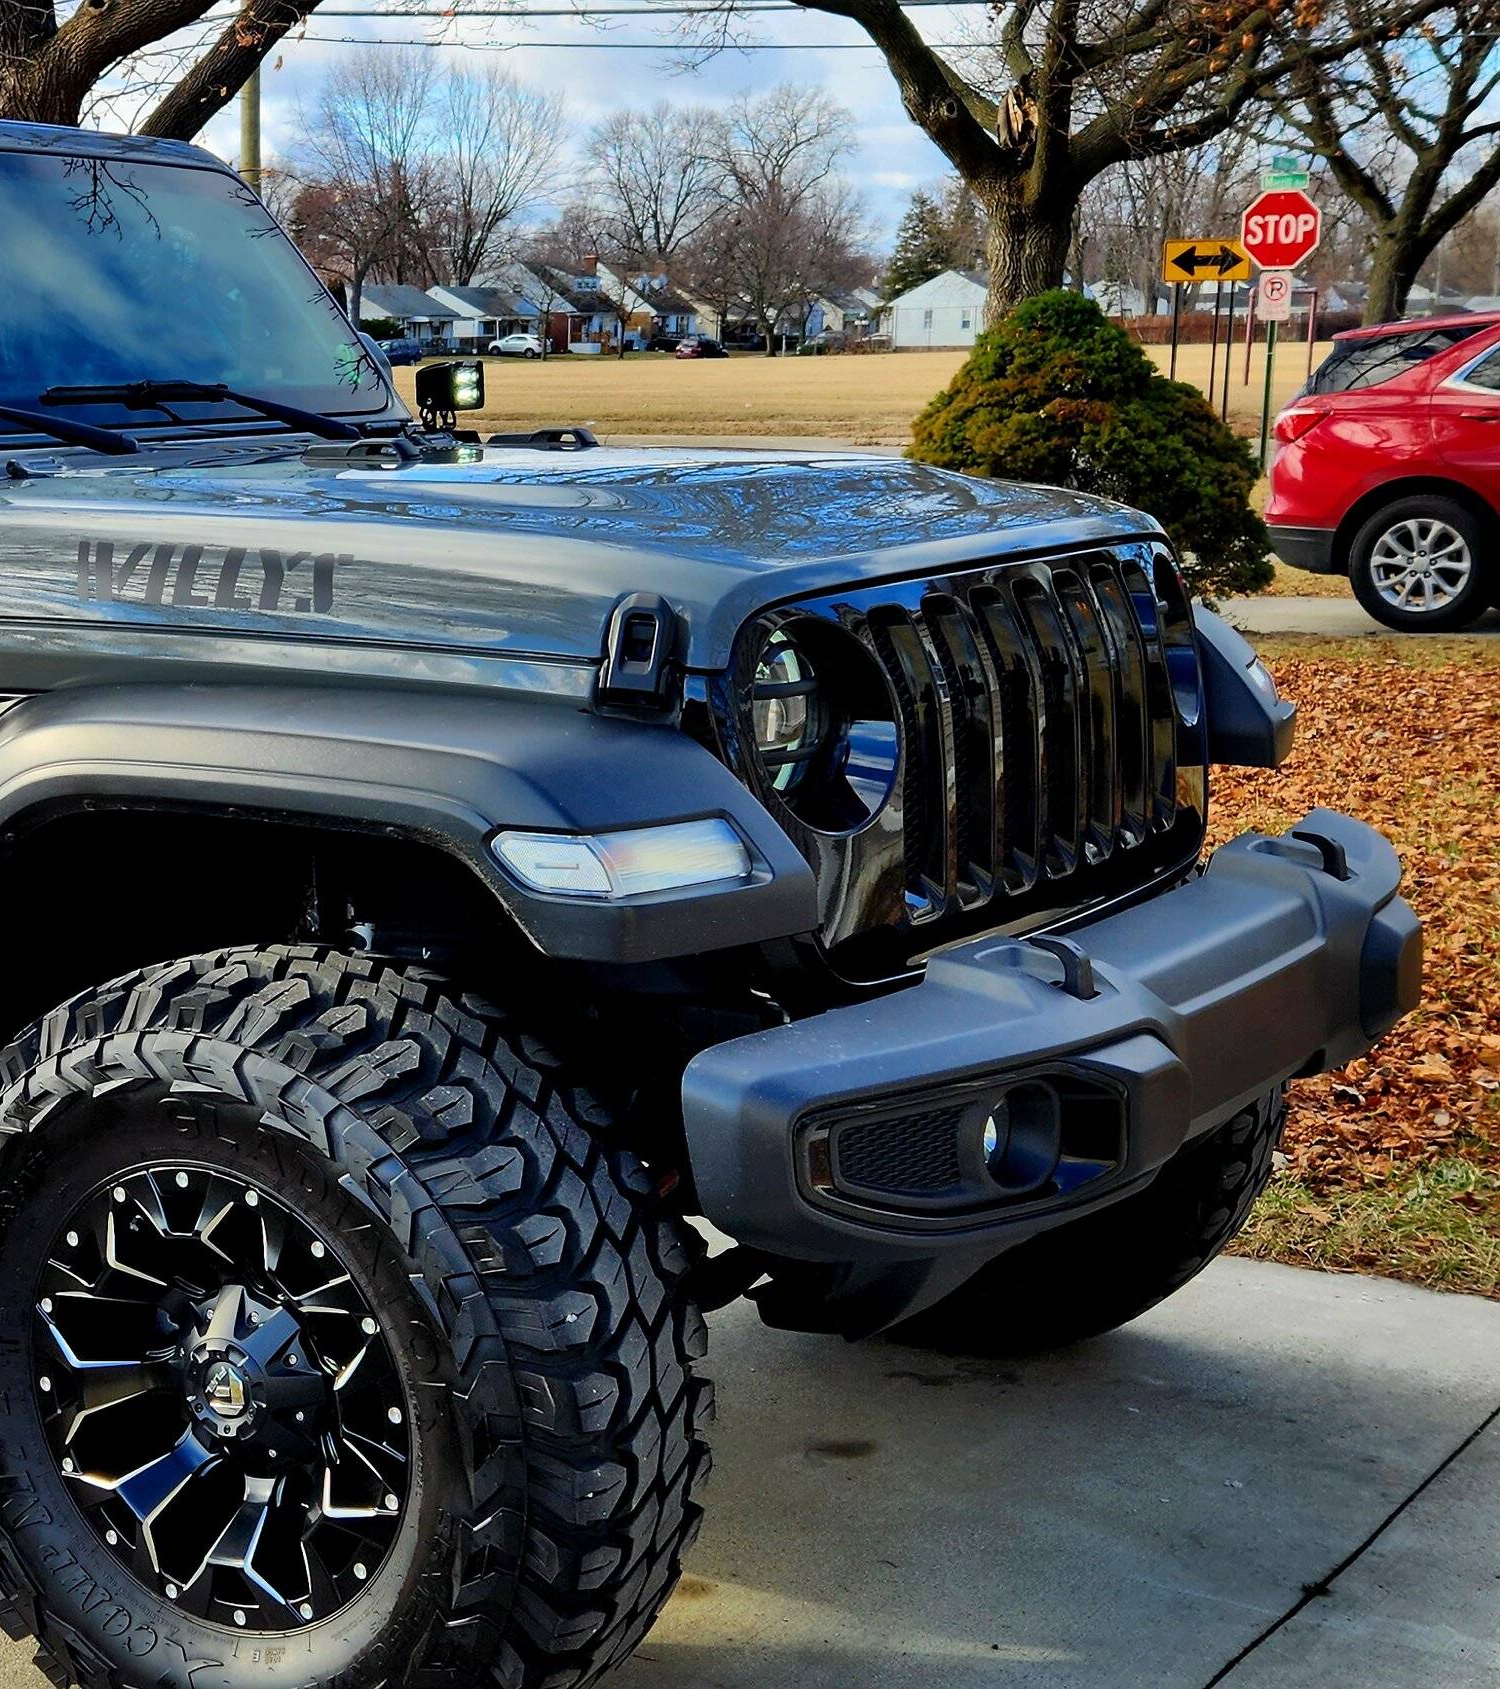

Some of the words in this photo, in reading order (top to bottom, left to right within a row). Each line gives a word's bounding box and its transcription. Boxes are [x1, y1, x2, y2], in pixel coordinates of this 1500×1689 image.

[1245, 213, 1315, 246] STOP
[77, 541, 354, 613] WILLYS
[205, 1366, 228, 1393] FUEL
